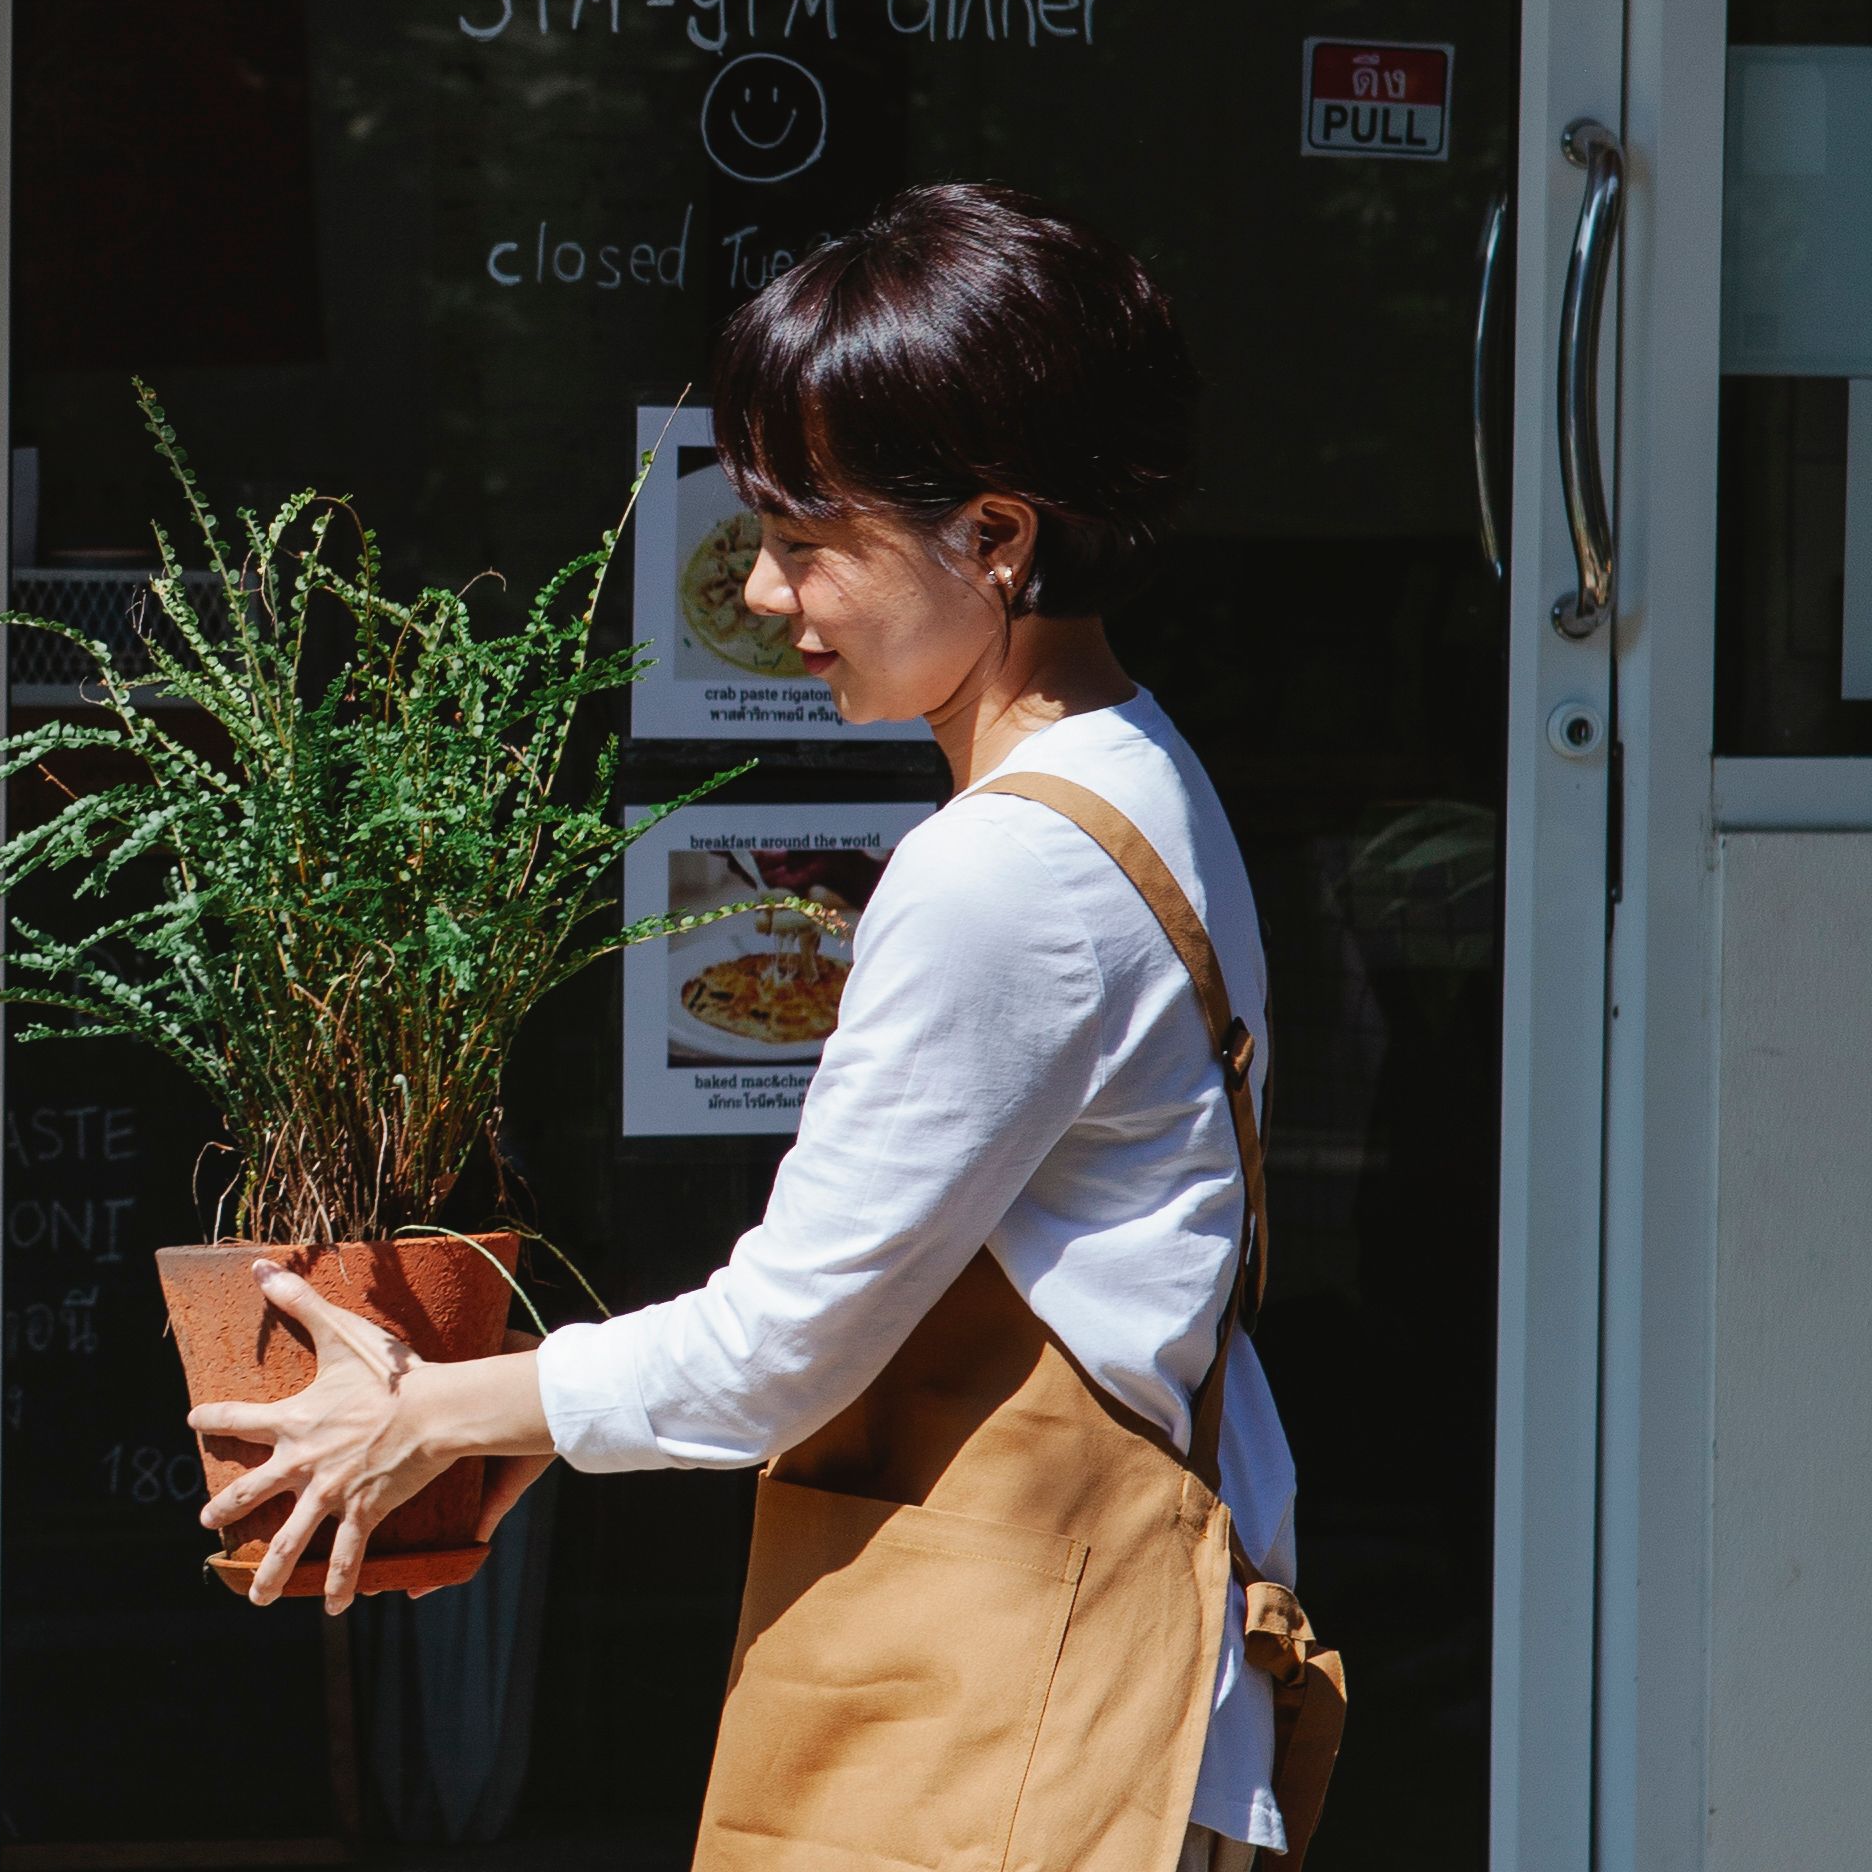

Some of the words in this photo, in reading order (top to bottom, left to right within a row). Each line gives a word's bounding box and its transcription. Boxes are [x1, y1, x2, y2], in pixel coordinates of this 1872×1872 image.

[1322, 105, 1427, 145] PULL
[487, 203, 692, 289] closed
[705, 686, 736, 702] crab
[740, 687, 778, 704] paste
[782, 686, 832, 705] rigaton
[690, 835, 756, 850] breakfast
[760, 834, 810, 849] around
[814, 834, 836, 848] the
[841, 834, 881, 848] world
[695, 1074, 737, 1089] baked
[741, 1074, 811, 1089] mac&che
